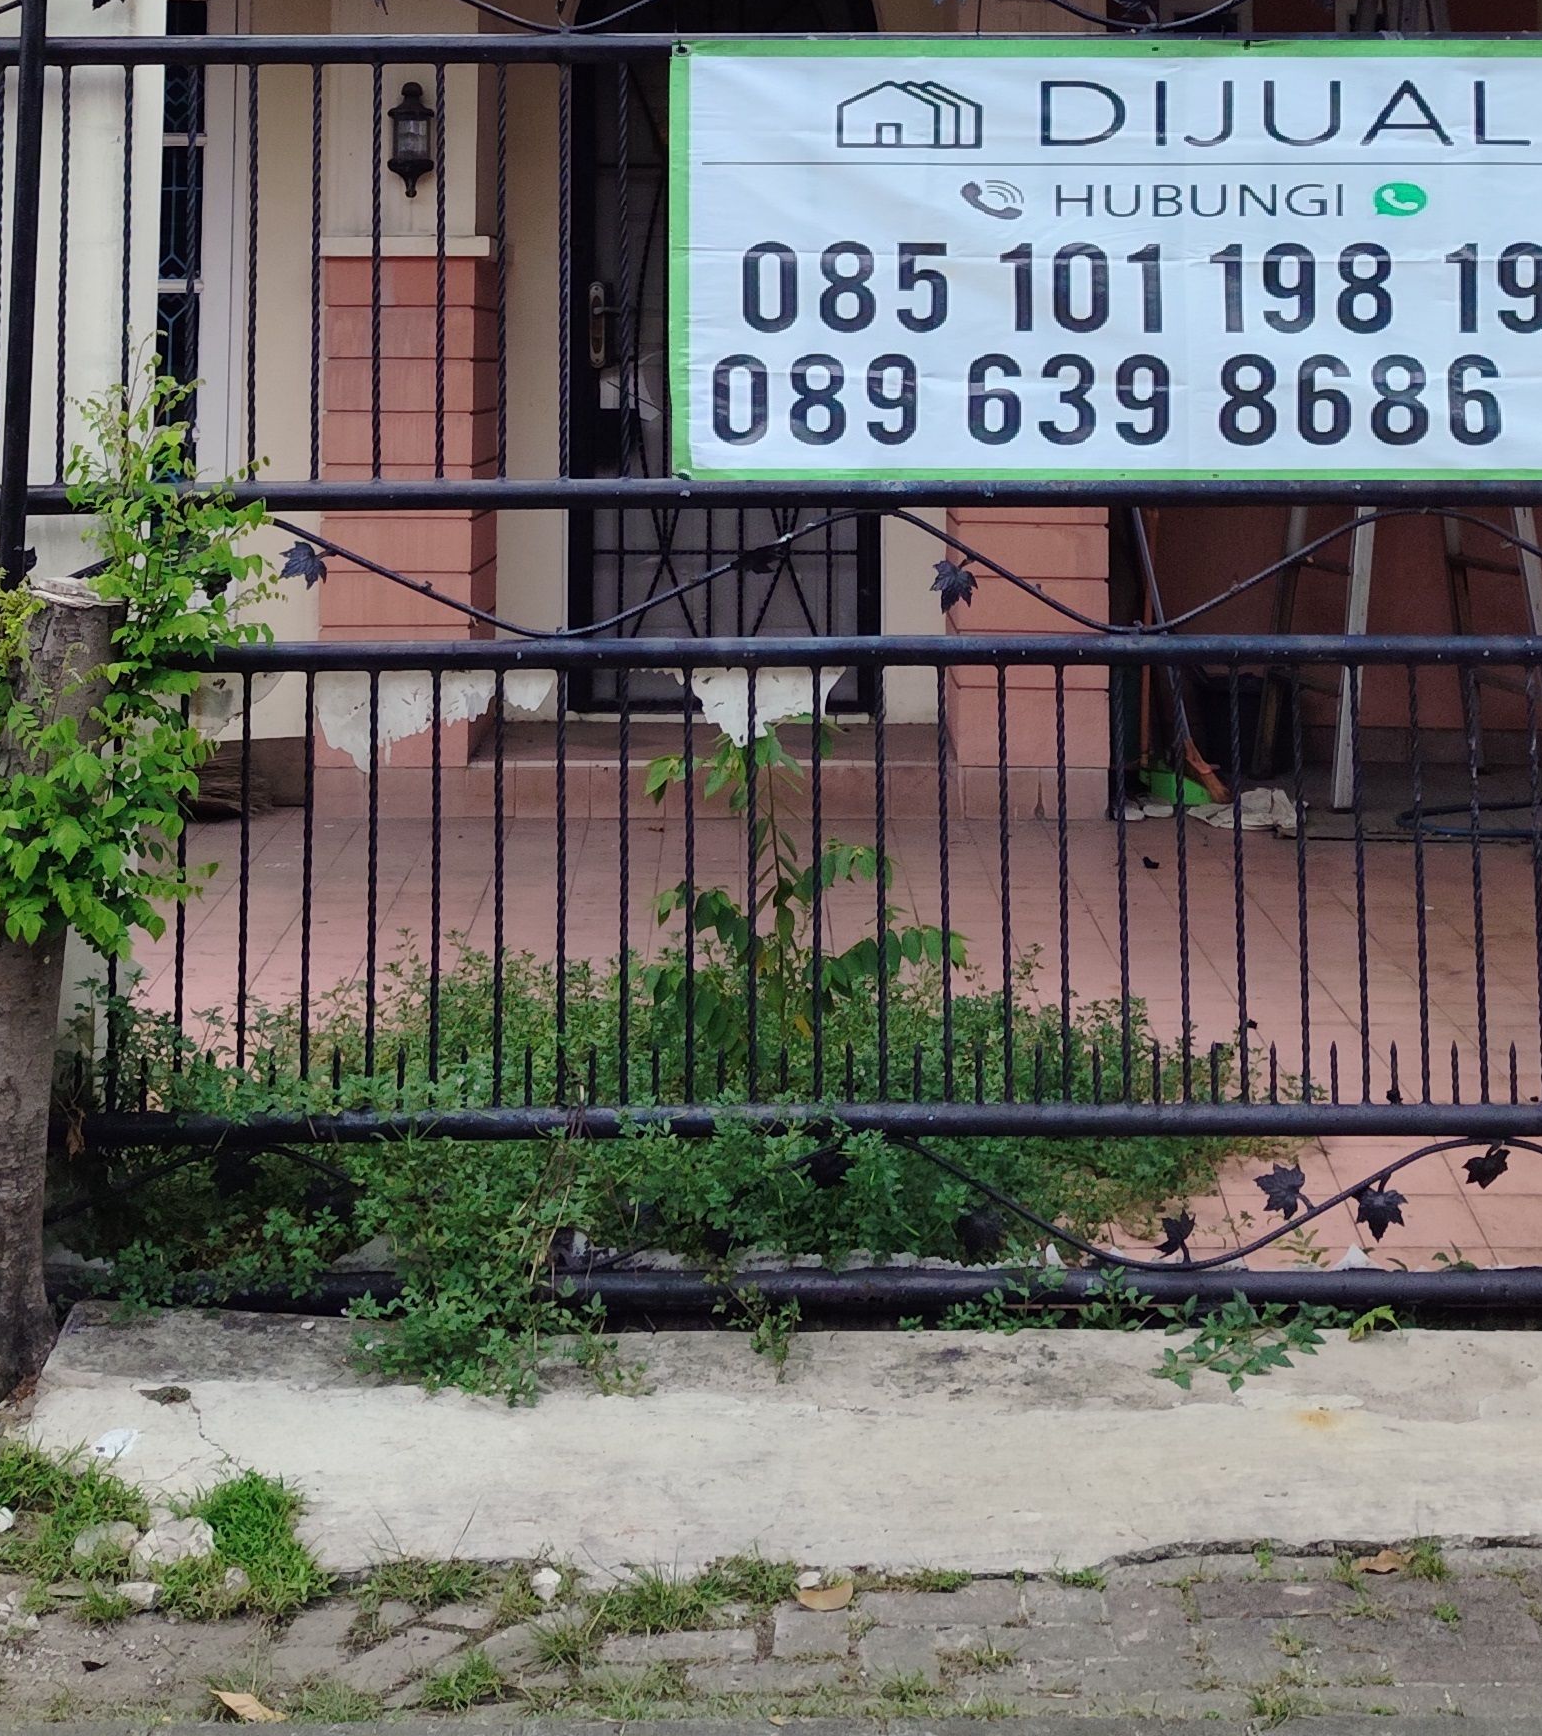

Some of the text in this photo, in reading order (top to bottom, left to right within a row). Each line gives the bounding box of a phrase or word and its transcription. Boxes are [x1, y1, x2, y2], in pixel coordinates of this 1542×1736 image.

[1040, 79, 1532, 148] DIJUAL
[1055, 183, 1344, 218] HUBUNGI
[742, 240, 948, 334] 085
[999, 242, 1163, 334] 101
[1209, 242, 1394, 335] 198
[712, 353, 917, 446] 089
[967, 352, 1170, 446] 639
[1218, 353, 1502, 447] 8686
